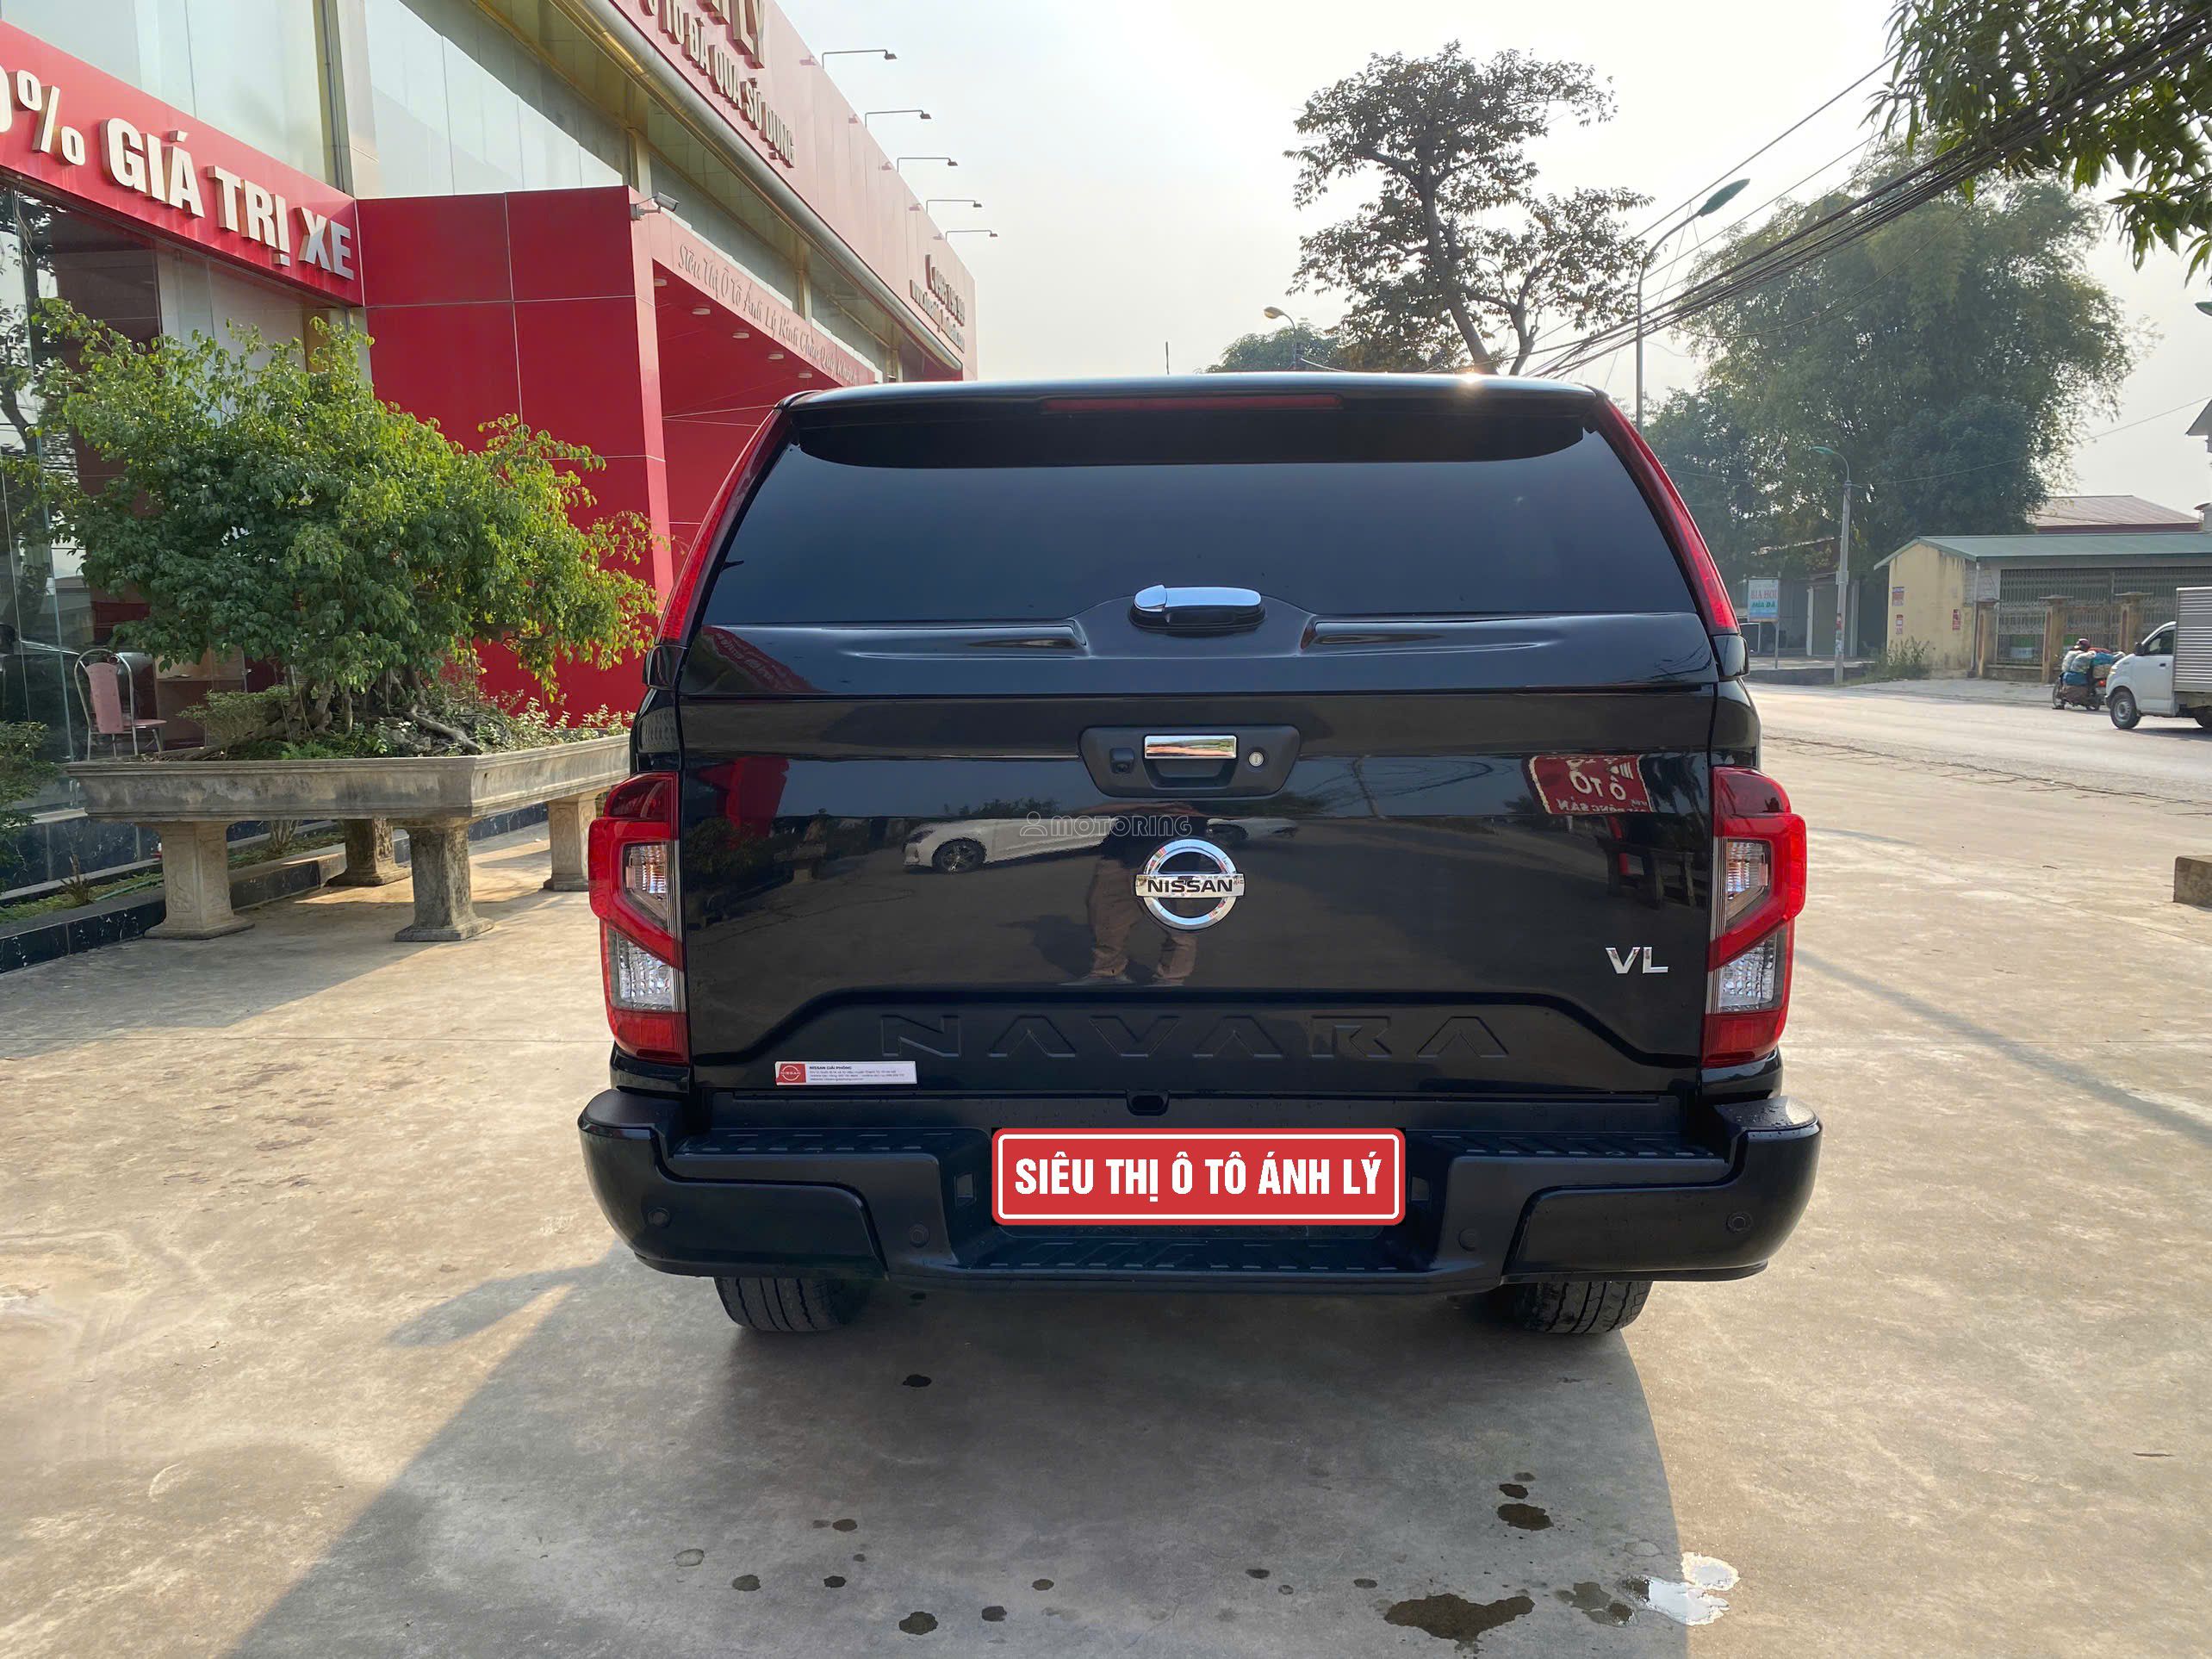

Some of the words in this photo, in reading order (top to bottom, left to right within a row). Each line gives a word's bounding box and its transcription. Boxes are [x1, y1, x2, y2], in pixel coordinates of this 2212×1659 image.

[711, 49, 743, 109] QUA
[762, 103, 794, 168] DỤNG
[101, 118, 204, 218] GIÁ
[209, 165, 290, 266] TRỊ
[295, 207, 354, 280] XE
[1146, 879, 1233, 894] NISSAN
[1605, 947, 1668, 974] VL
[880, 1015, 1510, 1058] NAVARA
